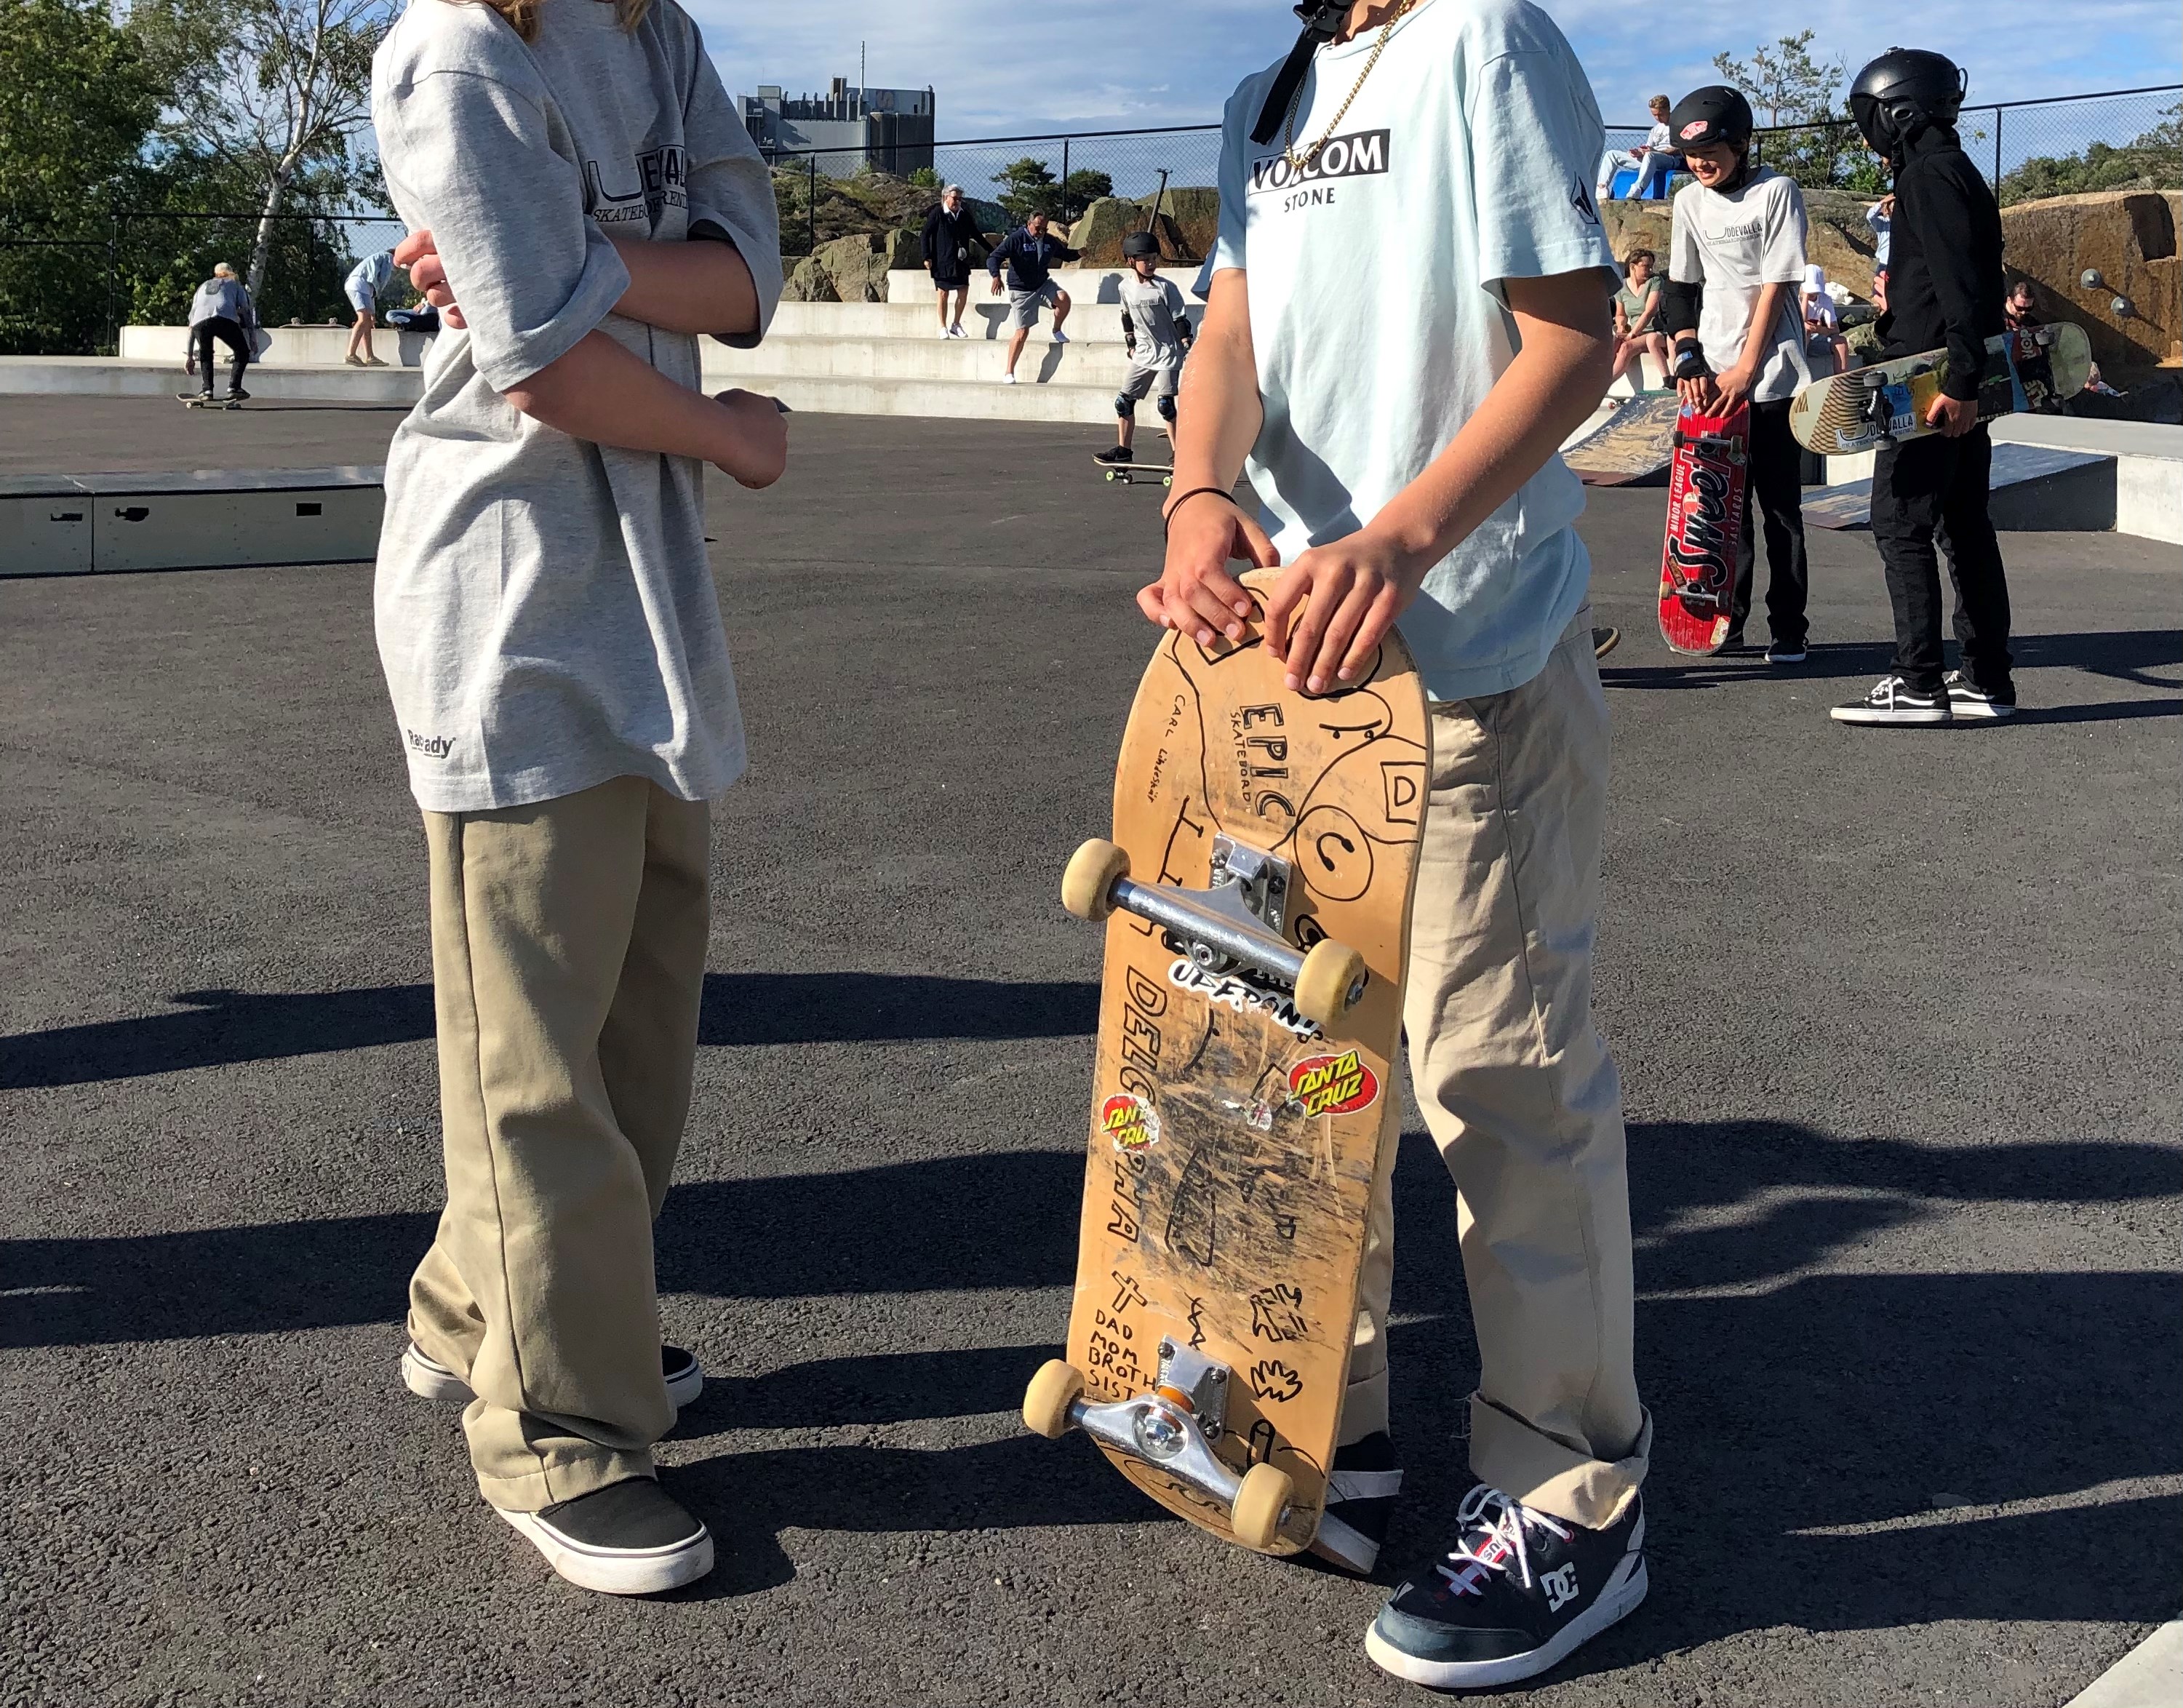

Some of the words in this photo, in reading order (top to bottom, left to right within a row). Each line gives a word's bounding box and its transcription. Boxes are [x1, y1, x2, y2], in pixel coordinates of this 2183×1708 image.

[1284, 187, 1336, 213] STONE
[1672, 463, 1685, 500] LEAGUE
[1667, 447, 1732, 588] Sweet
[1670, 500, 1681, 533] MINOR
[1165, 694, 1186, 738] CARL
[1229, 711, 1251, 803] SKATEBORD
[1239, 702, 1296, 817] EPIC
[1290, 1050, 1360, 1101] SANTA
[1306, 1072, 1363, 1117] CRUZ
[1117, 1125, 1150, 1147] CRU
[1095, 1308, 1133, 1341] DAD
[1090, 1330, 1138, 1365] MOM
